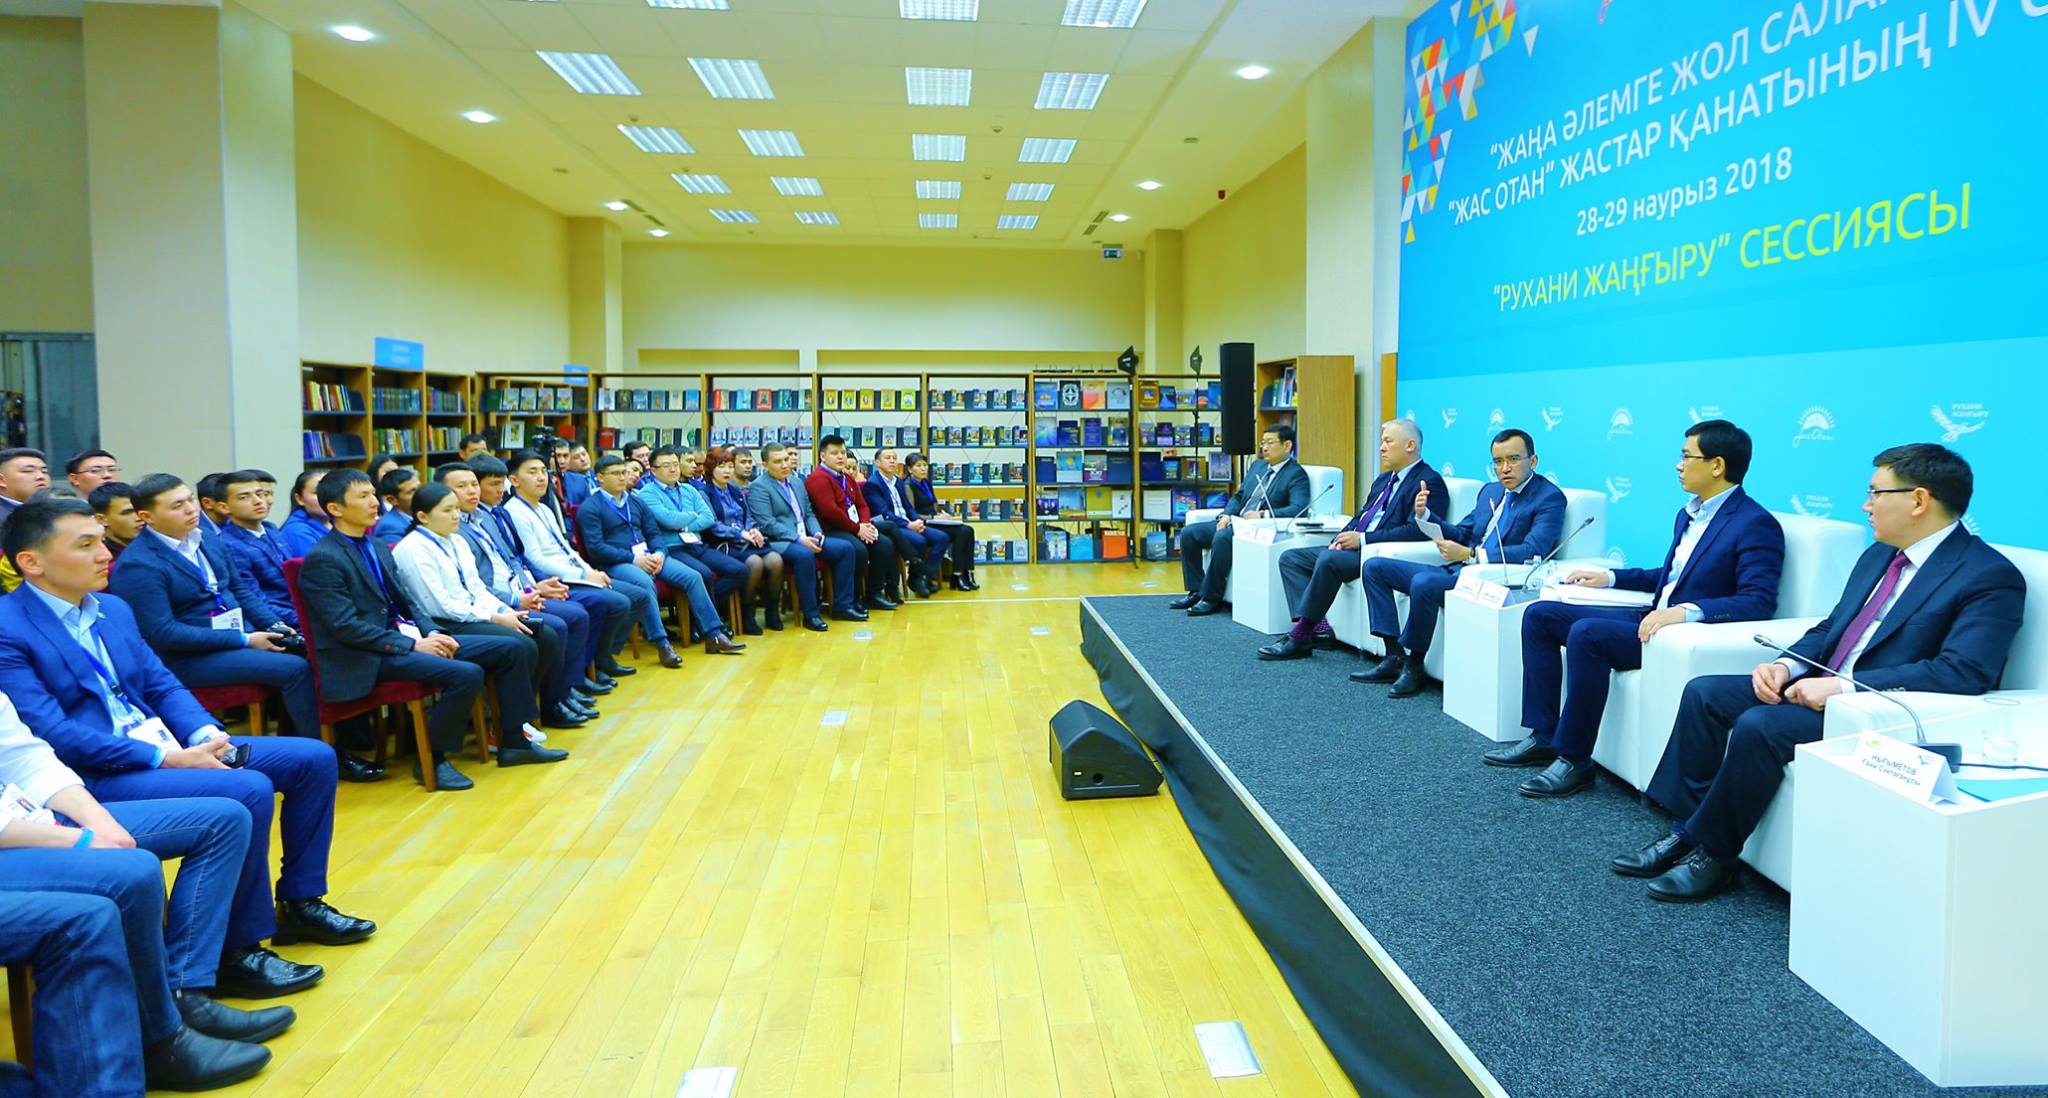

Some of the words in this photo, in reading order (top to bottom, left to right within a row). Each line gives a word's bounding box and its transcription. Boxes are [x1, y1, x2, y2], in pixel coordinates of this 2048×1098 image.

[1448, 187, 1491, 225] “ЖАС
[1495, 160, 1555, 210] ОТАН”
[1559, 121, 1662, 188] ЖАСТАР
[1669, 12, 1932, 153] ҚАНАТЫНЫҢ
[1948, 0, 1998, 48] IV
[1490, 118, 1558, 170] “ЖАҢА
[1563, 67, 1663, 141] ӘЛЕМГЕ
[1670, 27, 1749, 96] ЖОЛ
[1494, 269, 1578, 312] “РУХАНИ
[1584, 233, 1731, 296] ЖАҢҒЫРУ”
[1739, 182, 1970, 268] СЕССИЯСЫ
[1576, 197, 1628, 236] 28-29
[1633, 176, 1718, 221] наурыз
[1725, 146, 1793, 195] 2018
